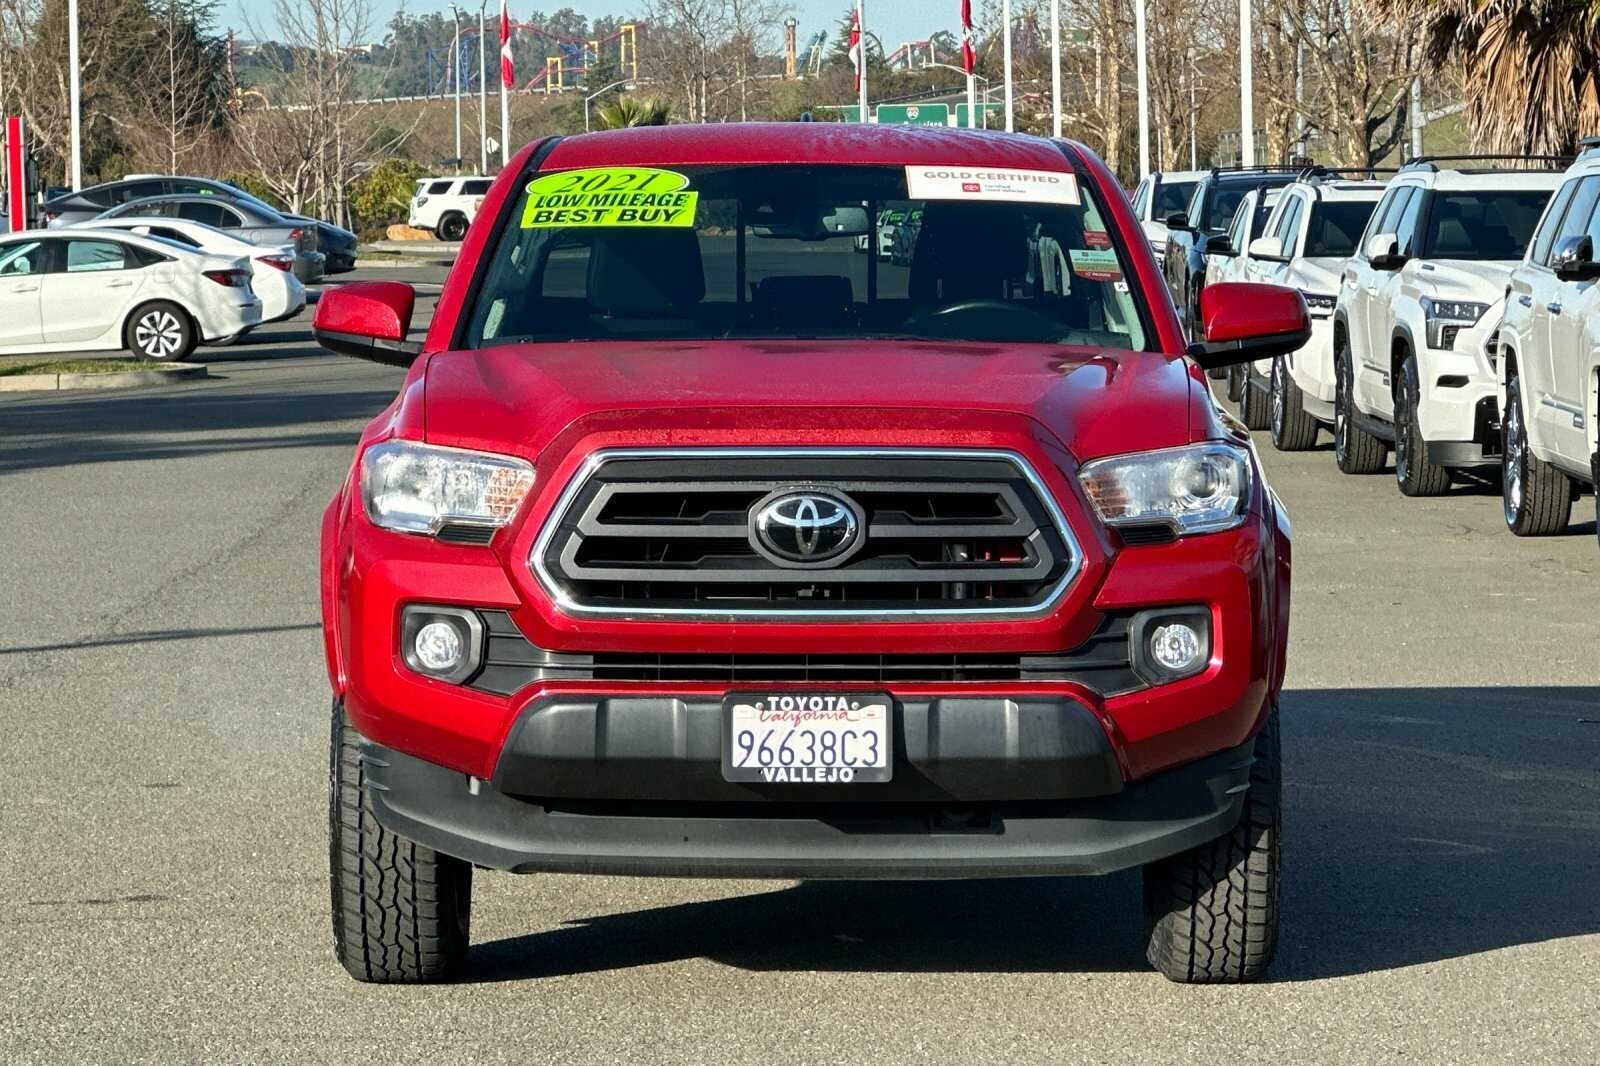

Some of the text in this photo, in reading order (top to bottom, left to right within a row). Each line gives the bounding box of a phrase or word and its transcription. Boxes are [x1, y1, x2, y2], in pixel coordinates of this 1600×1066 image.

[552, 174, 660, 193] 2021
[924, 171, 1060, 184] GOLD CERTIFIED
[535, 194, 688, 208] LOW MILEAGE
[533, 209, 684, 224] BEST BUY
[768, 696, 848, 711] TOYOTA
[760, 709, 855, 726] California
[738, 729, 878, 767] 96638C3
[763, 768, 854, 782] VALLEJO
